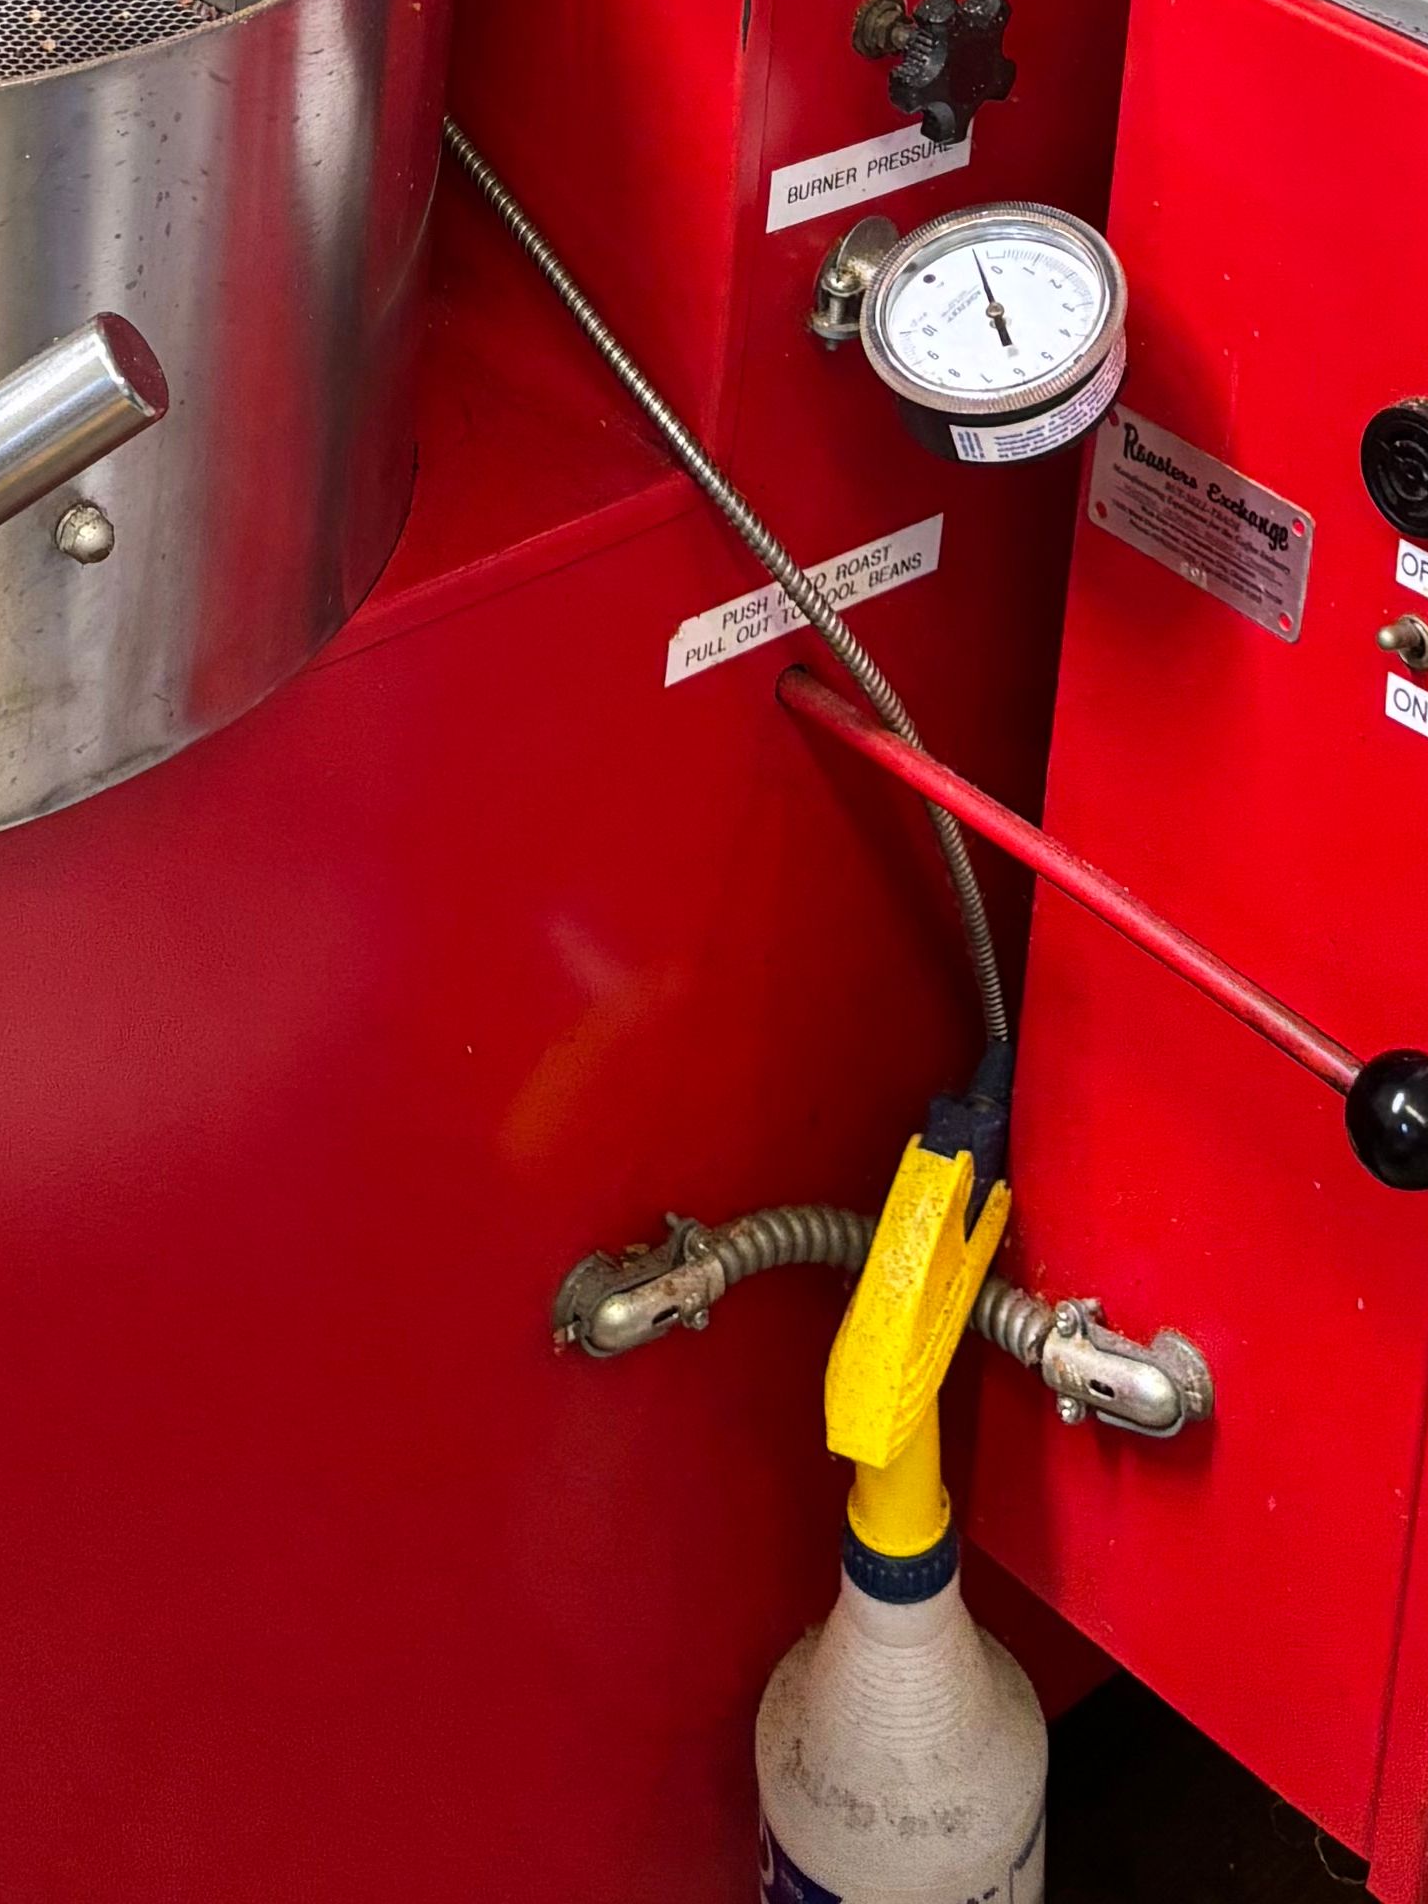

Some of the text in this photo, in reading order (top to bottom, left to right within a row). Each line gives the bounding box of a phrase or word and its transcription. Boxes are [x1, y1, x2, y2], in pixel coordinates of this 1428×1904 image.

[787, 165, 858, 205] BURNER
[1123, 421, 1198, 490] Roasters
[1207, 483, 1290, 552] Exchange
[685, 636, 727, 667] PULL
[736, 615, 774, 644] OUT
[822, 583, 858, 608] OOL
[868, 552, 923, 589] BEANS
[722, 595, 768, 630] PUSH
[836, 544, 893, 579] ROAST
